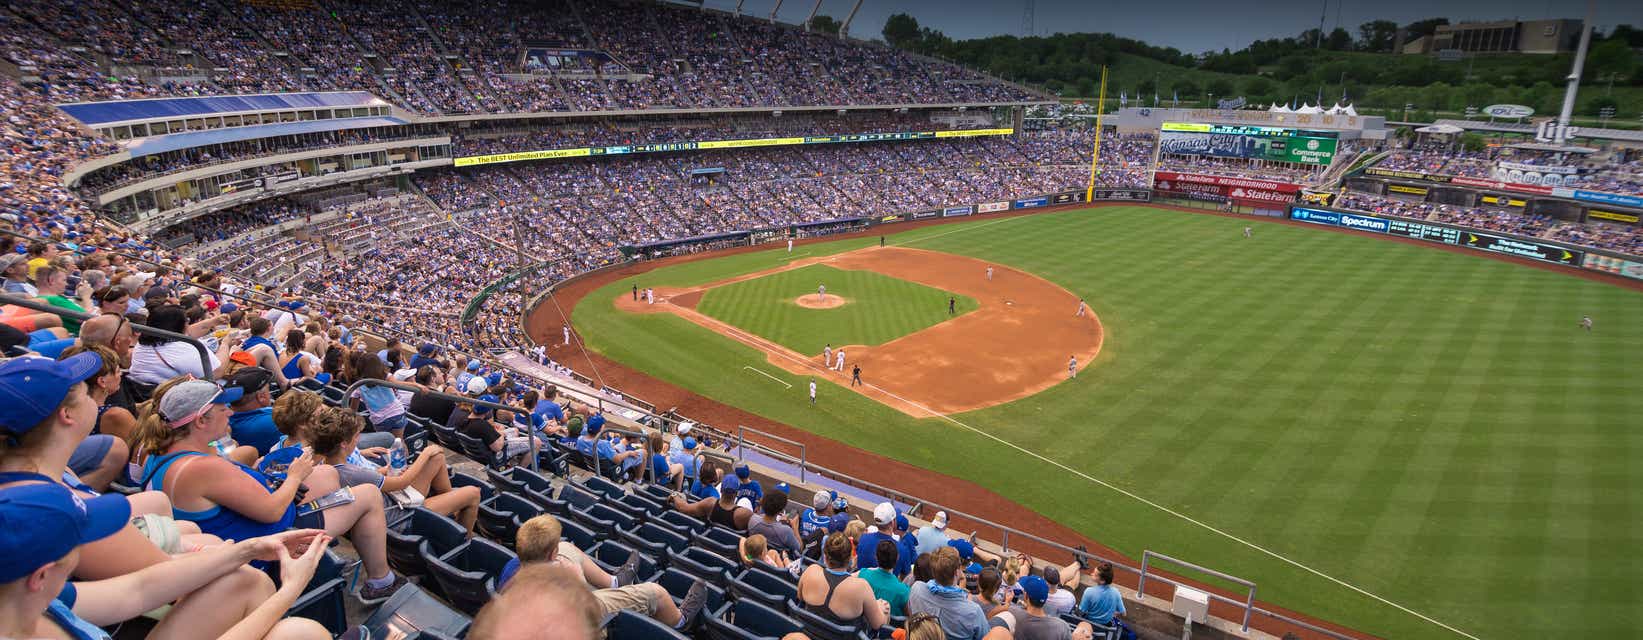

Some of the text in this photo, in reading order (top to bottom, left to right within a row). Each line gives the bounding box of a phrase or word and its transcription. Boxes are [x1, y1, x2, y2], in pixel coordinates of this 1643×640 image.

[1535, 119, 1579, 143] Lite
[1161, 133, 1235, 153] Kansas City
[508, 152, 539, 161] Unlimited
[1292, 148, 1331, 158] Commerce
[1218, 178, 1278, 189] NEIGHBORHOOD
[1327, 215, 1338, 223] City
[1341, 216, 1385, 230] Spectrum
[1511, 242, 1538, 251] Network
[1514, 248, 1546, 258] Unlimited
